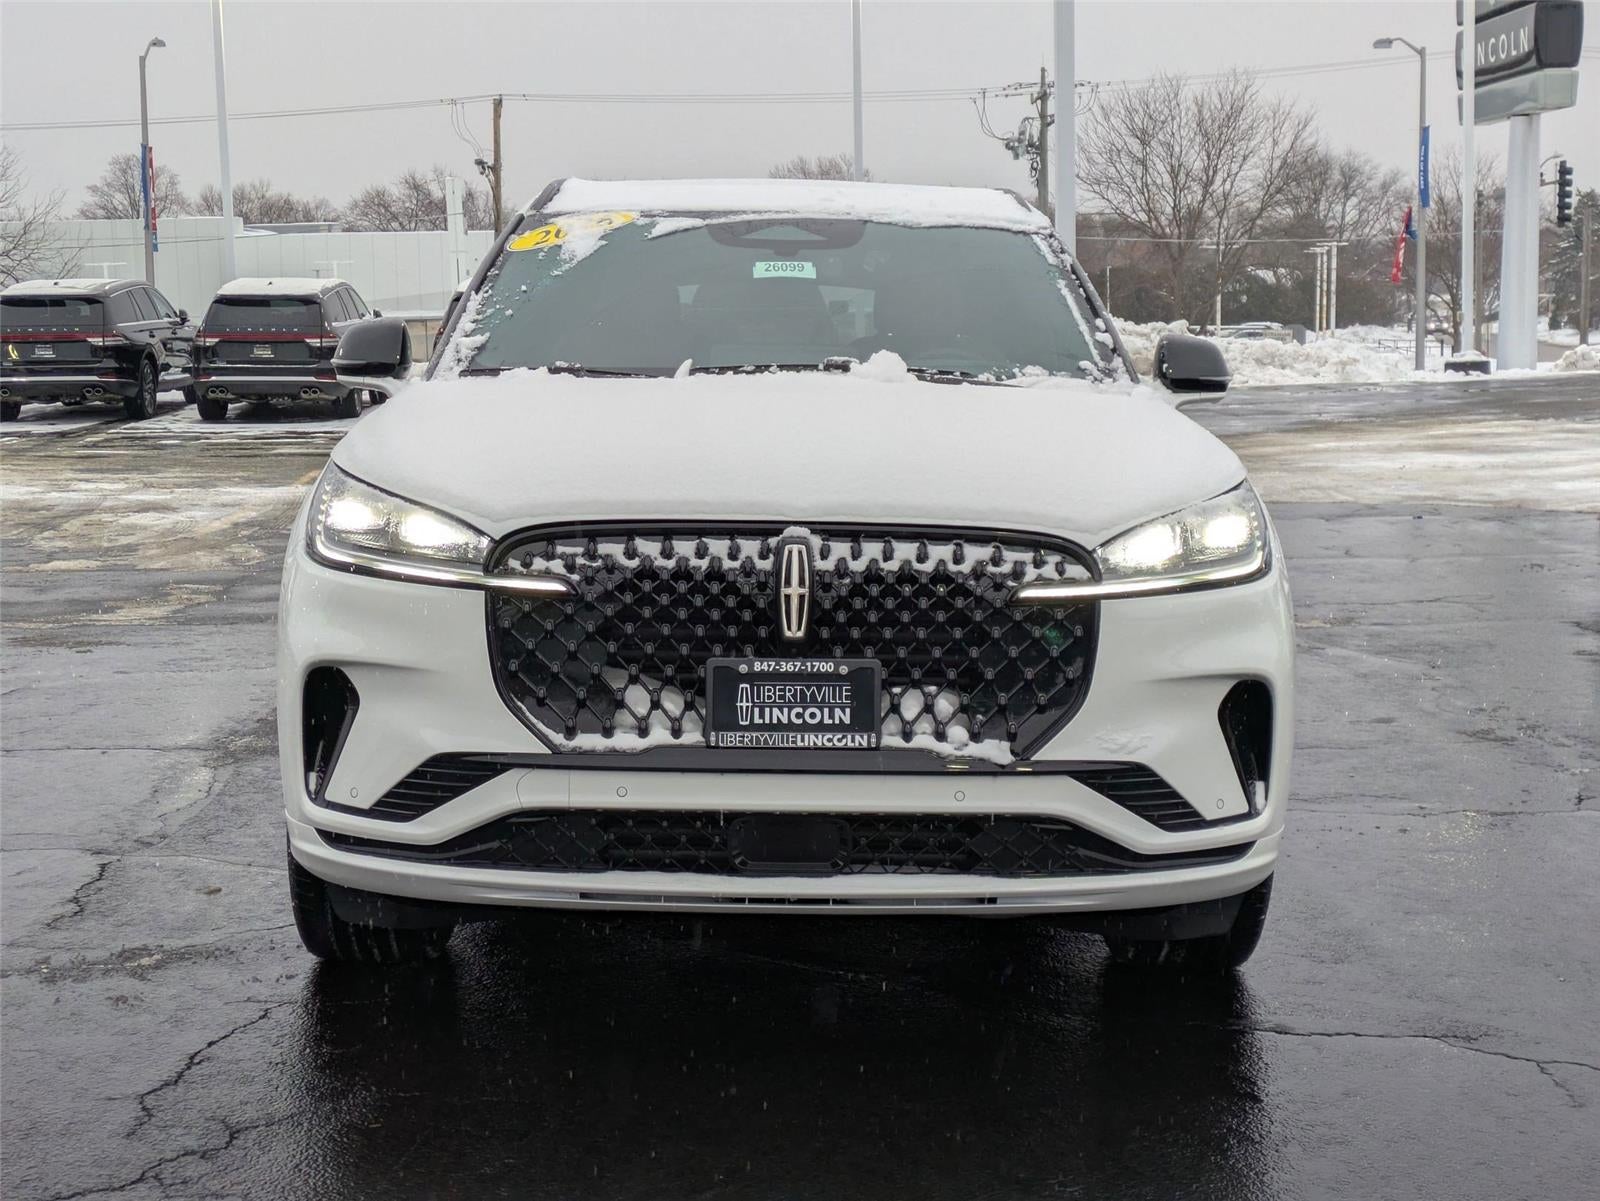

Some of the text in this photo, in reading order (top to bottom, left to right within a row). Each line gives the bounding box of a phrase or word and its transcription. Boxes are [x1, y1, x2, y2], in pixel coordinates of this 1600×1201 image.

[1477, 26, 1529, 66] NCOLN
[764, 262, 805, 272] 26099
[753, 661, 835, 672] 847-367-1700
[754, 685, 852, 703] LIBERTYVILLE
[753, 707, 851, 724] LINCOLN
